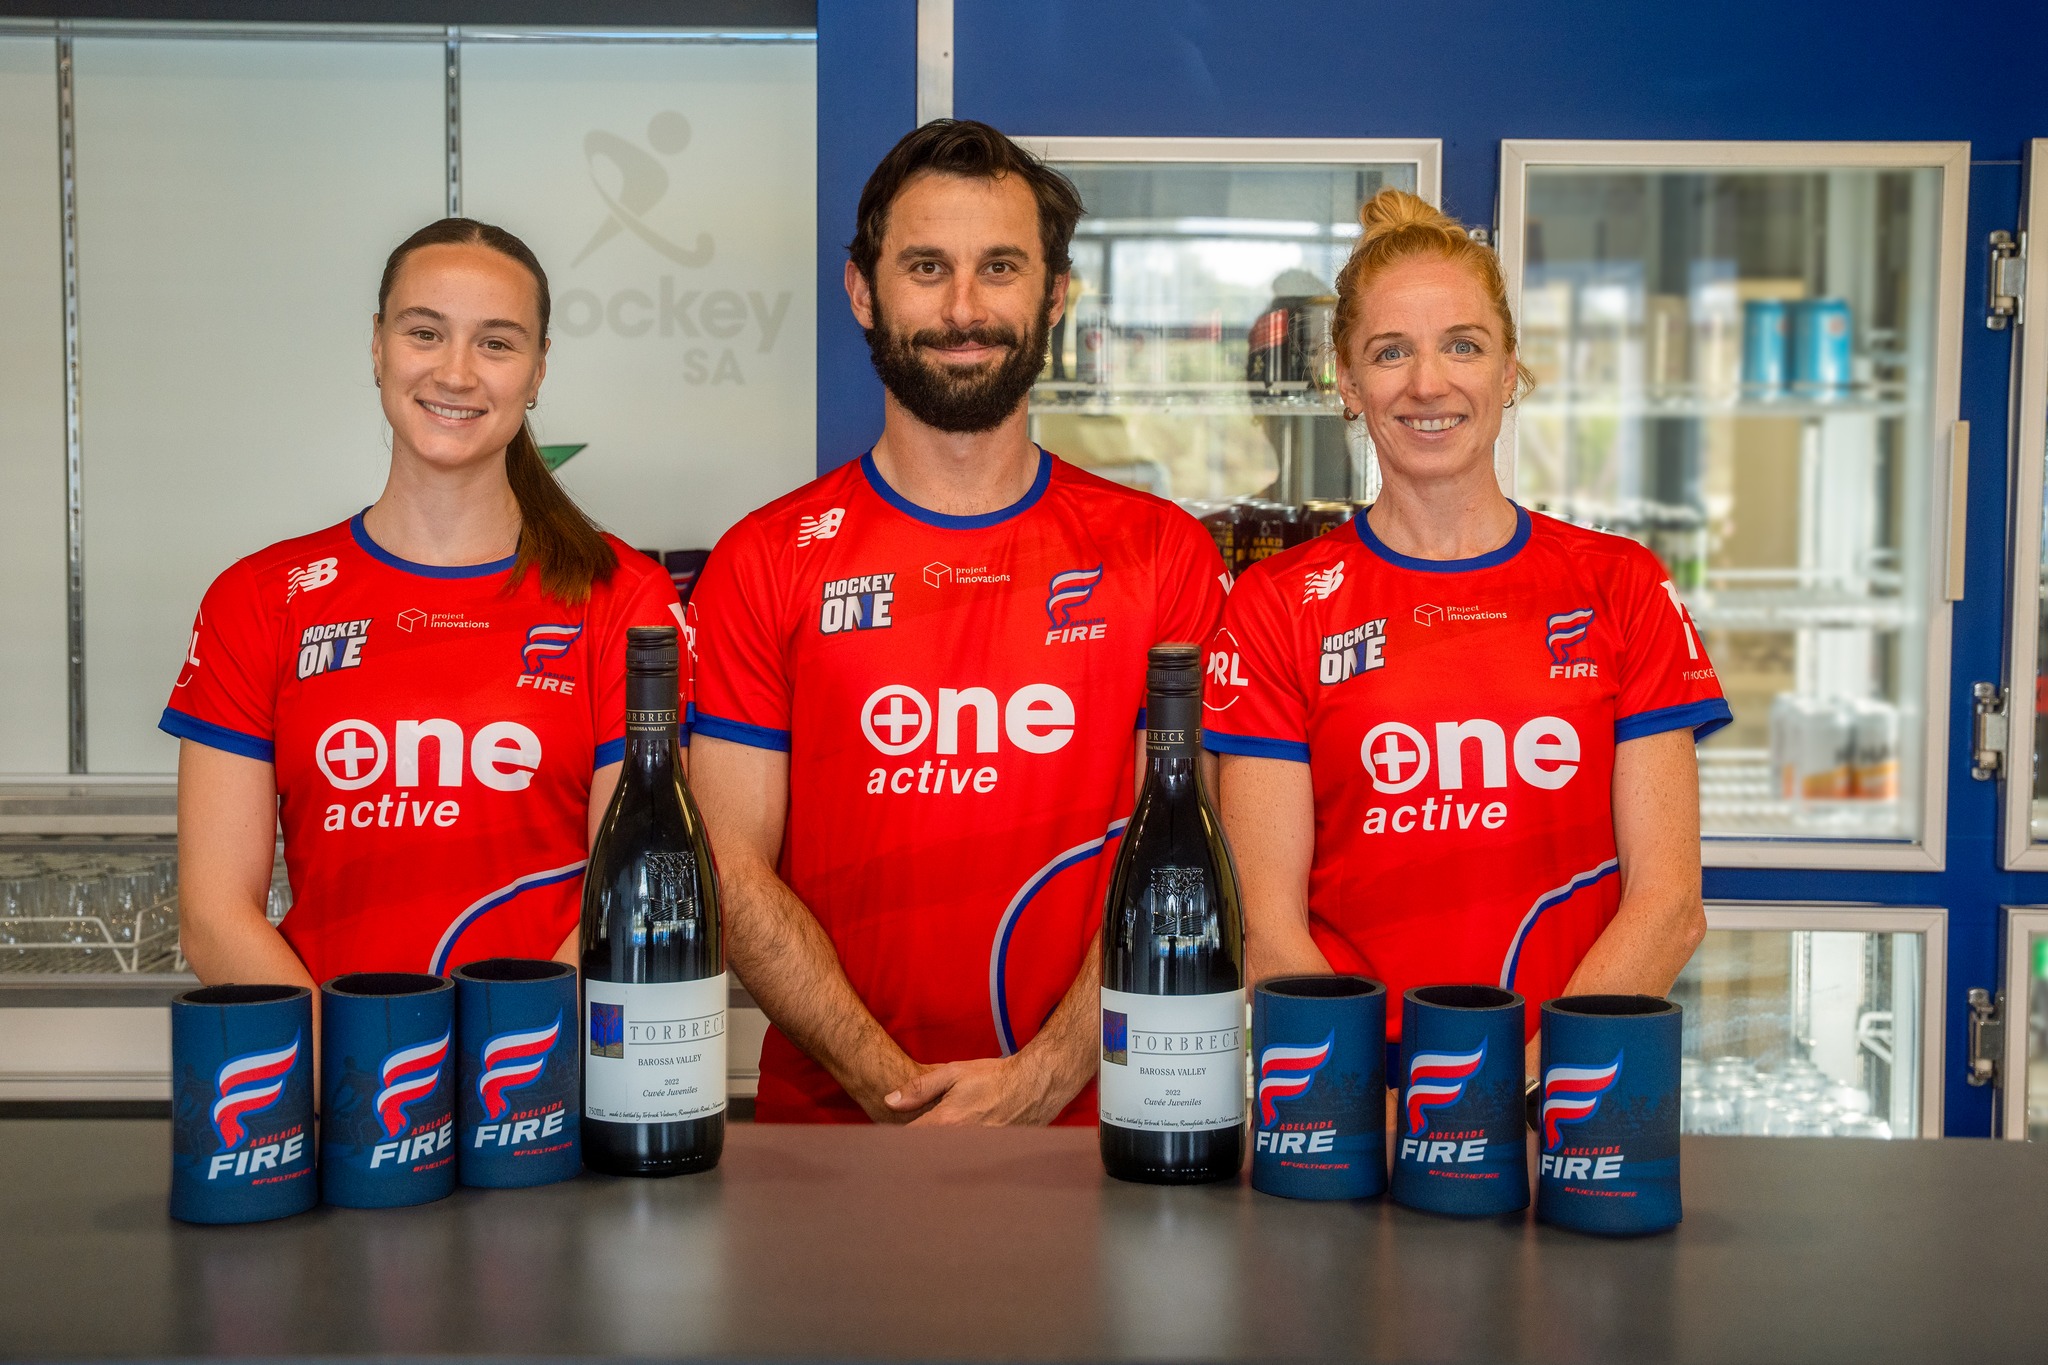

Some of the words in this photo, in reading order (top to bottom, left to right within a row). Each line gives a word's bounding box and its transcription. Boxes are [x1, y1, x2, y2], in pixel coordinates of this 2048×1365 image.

[553, 275, 793, 354] ockey
[682, 348, 746, 386] SA
[956, 566, 987, 576] project
[956, 574, 1011, 584] innovations
[824, 574, 895, 598] HOCKEY
[431, 612, 464, 623] project
[1447, 605, 1479, 615] project
[1448, 611, 1507, 621] innovations
[302, 619, 373, 645] HOCKEY
[431, 620, 490, 629] innovations
[1045, 624, 1107, 645] FIRE
[1323, 619, 1387, 652] HOCKEY
[1550, 663, 1598, 679] FIRE
[516, 675, 576, 696] FIRE
[867, 759, 998, 794] active
[324, 792, 460, 832] active
[1363, 795, 1507, 834] active
[629, 1014, 725, 1041] TORBRECK
[1132, 1031, 1239, 1051] TORBRECK
[638, 1057, 674, 1066] BAROSSA
[676, 1053, 702, 1064] VALLEY
[1139, 1066, 1175, 1076] BAROSSA
[1177, 1066, 1207, 1076] VALLEY
[642, 1089, 665, 1097] Cuvée
[667, 1086, 698, 1097] Juveniles
[512, 1100, 563, 1120] ADELAIDE
[1144, 1098, 1166, 1106] Cuvée
[1168, 1098, 1202, 1107] Juveniles
[250, 1124, 302, 1148] ADELAIDE
[474, 1109, 565, 1148] FIRE
[1280, 1120, 1333, 1131] ADELAIDE
[1429, 1129, 1485, 1139] ADELAIDE
[370, 1120, 452, 1169] FIRE
[1257, 1129, 1337, 1154] FIRE
[1401, 1138, 1488, 1163] FIRE
[1563, 1145, 1620, 1155] ADELAIDE
[208, 1133, 304, 1180] FIRE
[1281, 1161, 1350, 1170] #FUELTHEFIRE
[1541, 1154, 1624, 1180] FIRE
